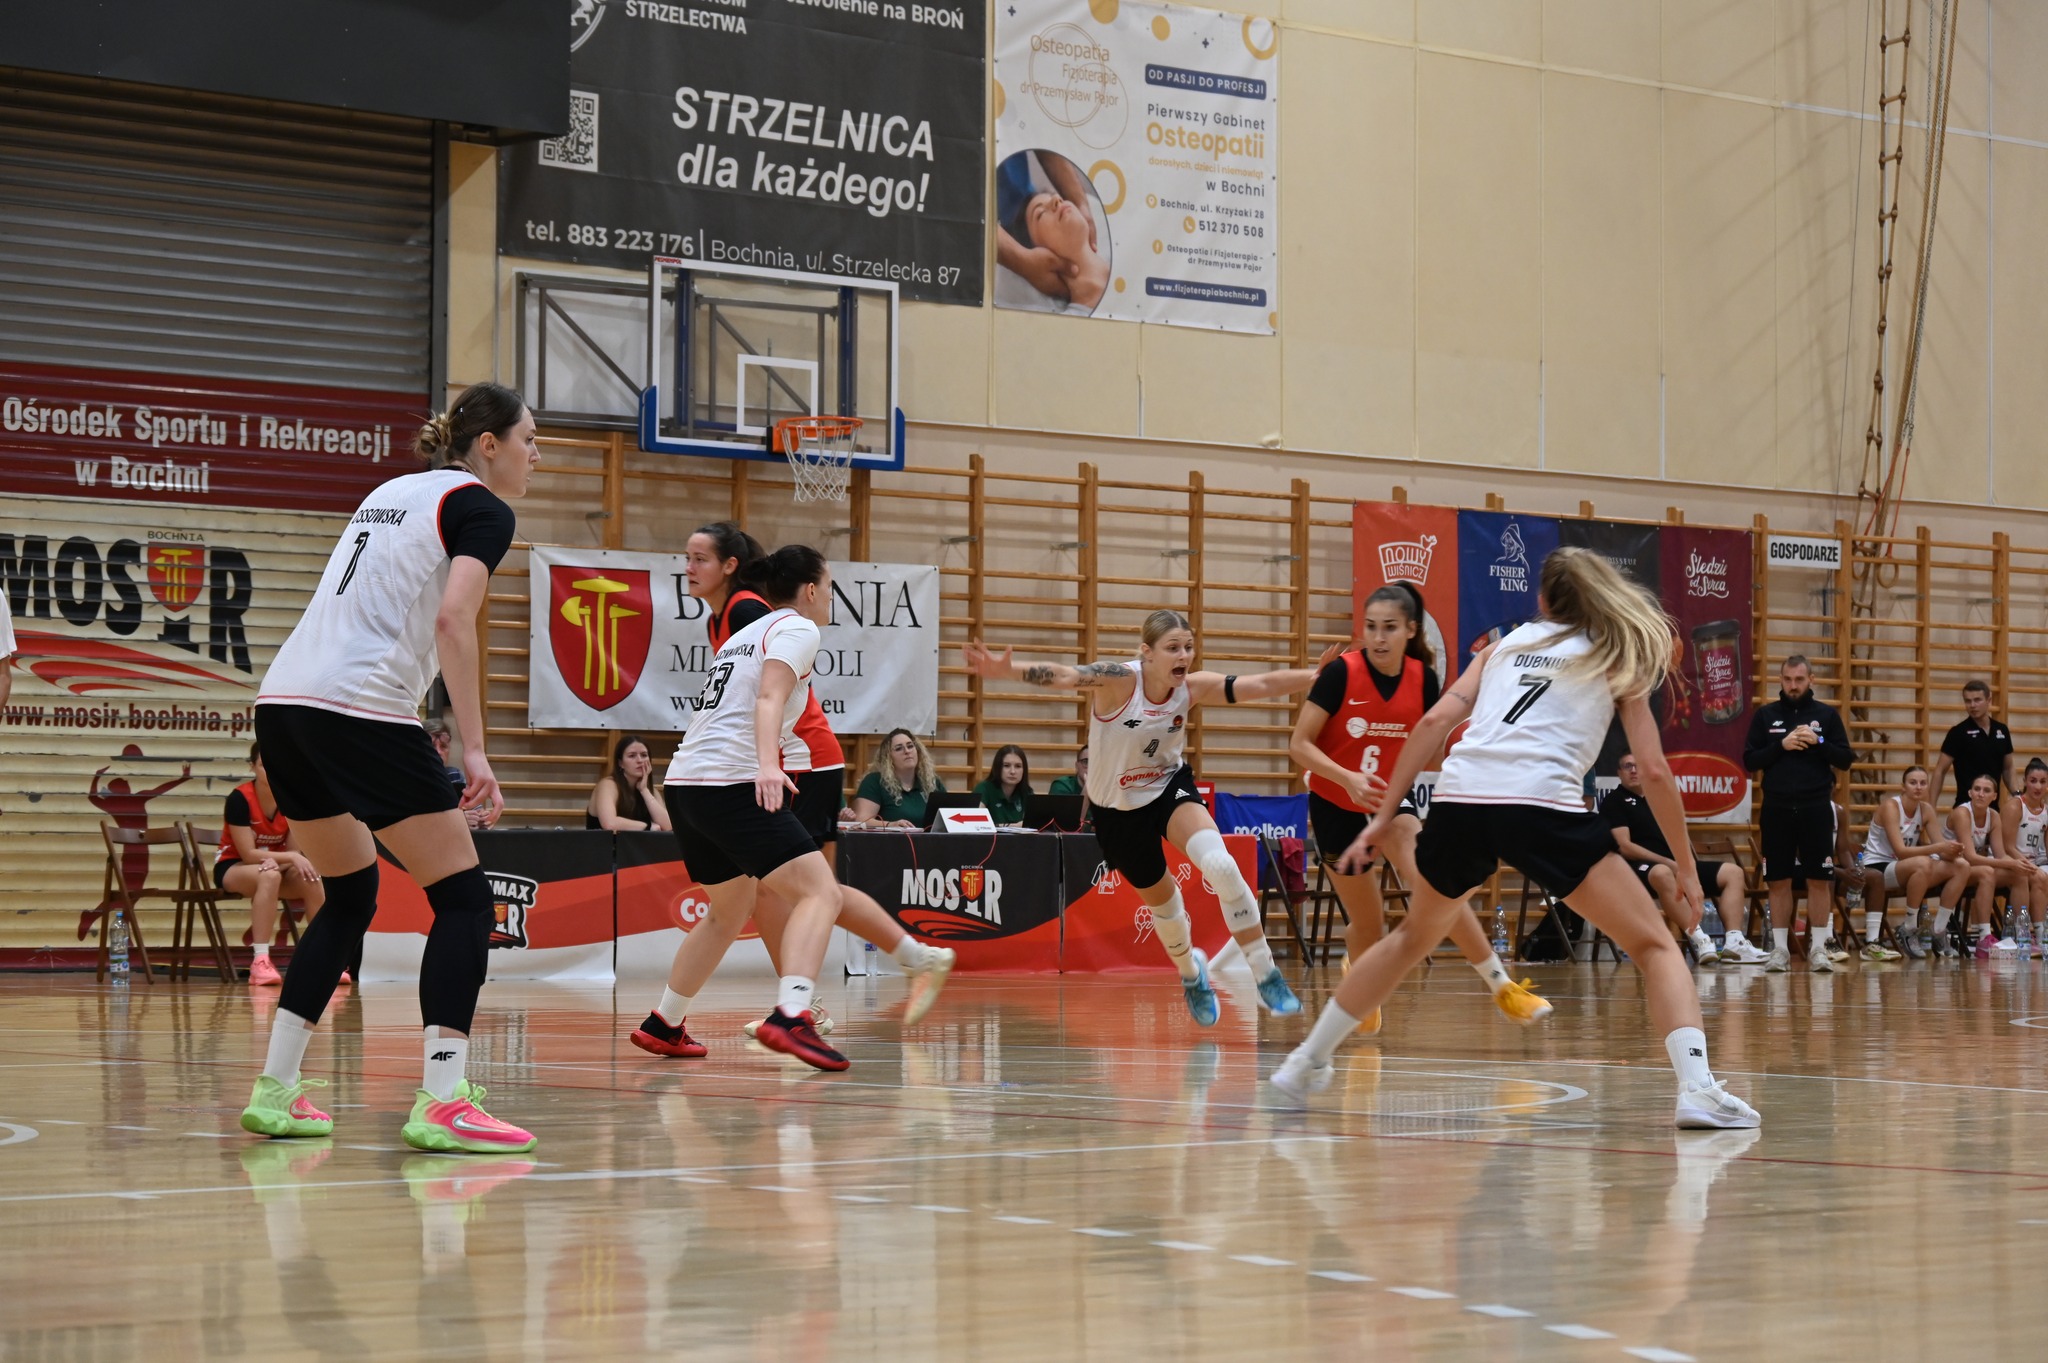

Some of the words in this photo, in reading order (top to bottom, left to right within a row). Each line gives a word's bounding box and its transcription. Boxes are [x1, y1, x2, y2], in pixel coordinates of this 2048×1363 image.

[626, 1, 747, 35] STRZELECTWA
[883, 3, 906, 20] na
[912, 4, 964, 30] BROŃ
[1030, 35, 1110, 62] Osteopatia
[1062, 63, 1117, 86] Fizjoterapia
[1148, 69, 1163, 80] OD
[1167, 71, 1195, 85] PASJI
[1199, 76, 1214, 88] DO
[1217, 79, 1264, 95] PROFESJI
[1020, 81, 1031, 93] dr
[672, 86, 934, 162] STRZELNICA
[1147, 103, 1208, 127] Pierwszy
[1213, 112, 1265, 131] Gabinet
[1146, 121, 1264, 161] Osteopatii
[677, 143, 739, 189] dla
[751, 150, 930, 218] każdego!
[1206, 181, 1216, 191] w
[1222, 180, 1265, 197] Bochni
[1160, 198, 1198, 213] Bochnia,
[1201, 204, 1213, 213] ul.
[1215, 205, 1252, 218] Krzyżaki
[1254, 210, 1265, 219] 28
[1198, 220, 1218, 233] 512
[1220, 222, 1239, 235] 370
[1243, 225, 1264, 238] 508
[525, 220, 561, 242] tel.
[567, 223, 608, 247] 883
[614, 228, 654, 251] 223
[659, 233, 694, 256] 176
[711, 239, 800, 272] Bochnia,
[806, 251, 826, 272] ul.
[832, 253, 932, 284] Strzelecka
[938, 266, 960, 287] 87
[1167, 244, 1209, 256] Osteopatia
[1214, 249, 1258, 262] Fizjoterapia
[1198, 258, 1241, 270] Przemysław
[1243, 263, 1262, 273] Pajor
[1153, 283, 1259, 302] www.fizjoterapiabochnia.pl
[3, 396, 122, 438] Ośrodek
[134, 405, 227, 448] Sportu
[239, 414, 248, 447] i
[259, 415, 391, 463] Rekreacji
[75, 460, 99, 486] w
[111, 455, 209, 493] Bochni
[147, 530, 205, 542] BOCHNIA
[1686, 547, 1728, 579] Śledzie
[1770, 542, 1839, 563] GOSPODARZE
[1387, 564, 1424, 579] WIŚNICZ
[1489, 565, 1525, 578] FISHER
[1500, 578, 1528, 593] KING
[1689, 576, 1700, 588] od
[1697, 575, 1727, 598] Serca
[813, 648, 864, 677] OLI
[1502, 673, 1553, 725] 7
[0, 702, 251, 738] ww.mosir.bochnia.pl
[1370, 722, 1406, 731] BASKET
[1143, 739, 1160, 758] 4
[1359, 745, 1381, 775] 6
[1675, 775, 1734, 794] NTIMAX
[1234, 822, 1296, 841] molten
[901, 868, 1003, 926] MOSIR
